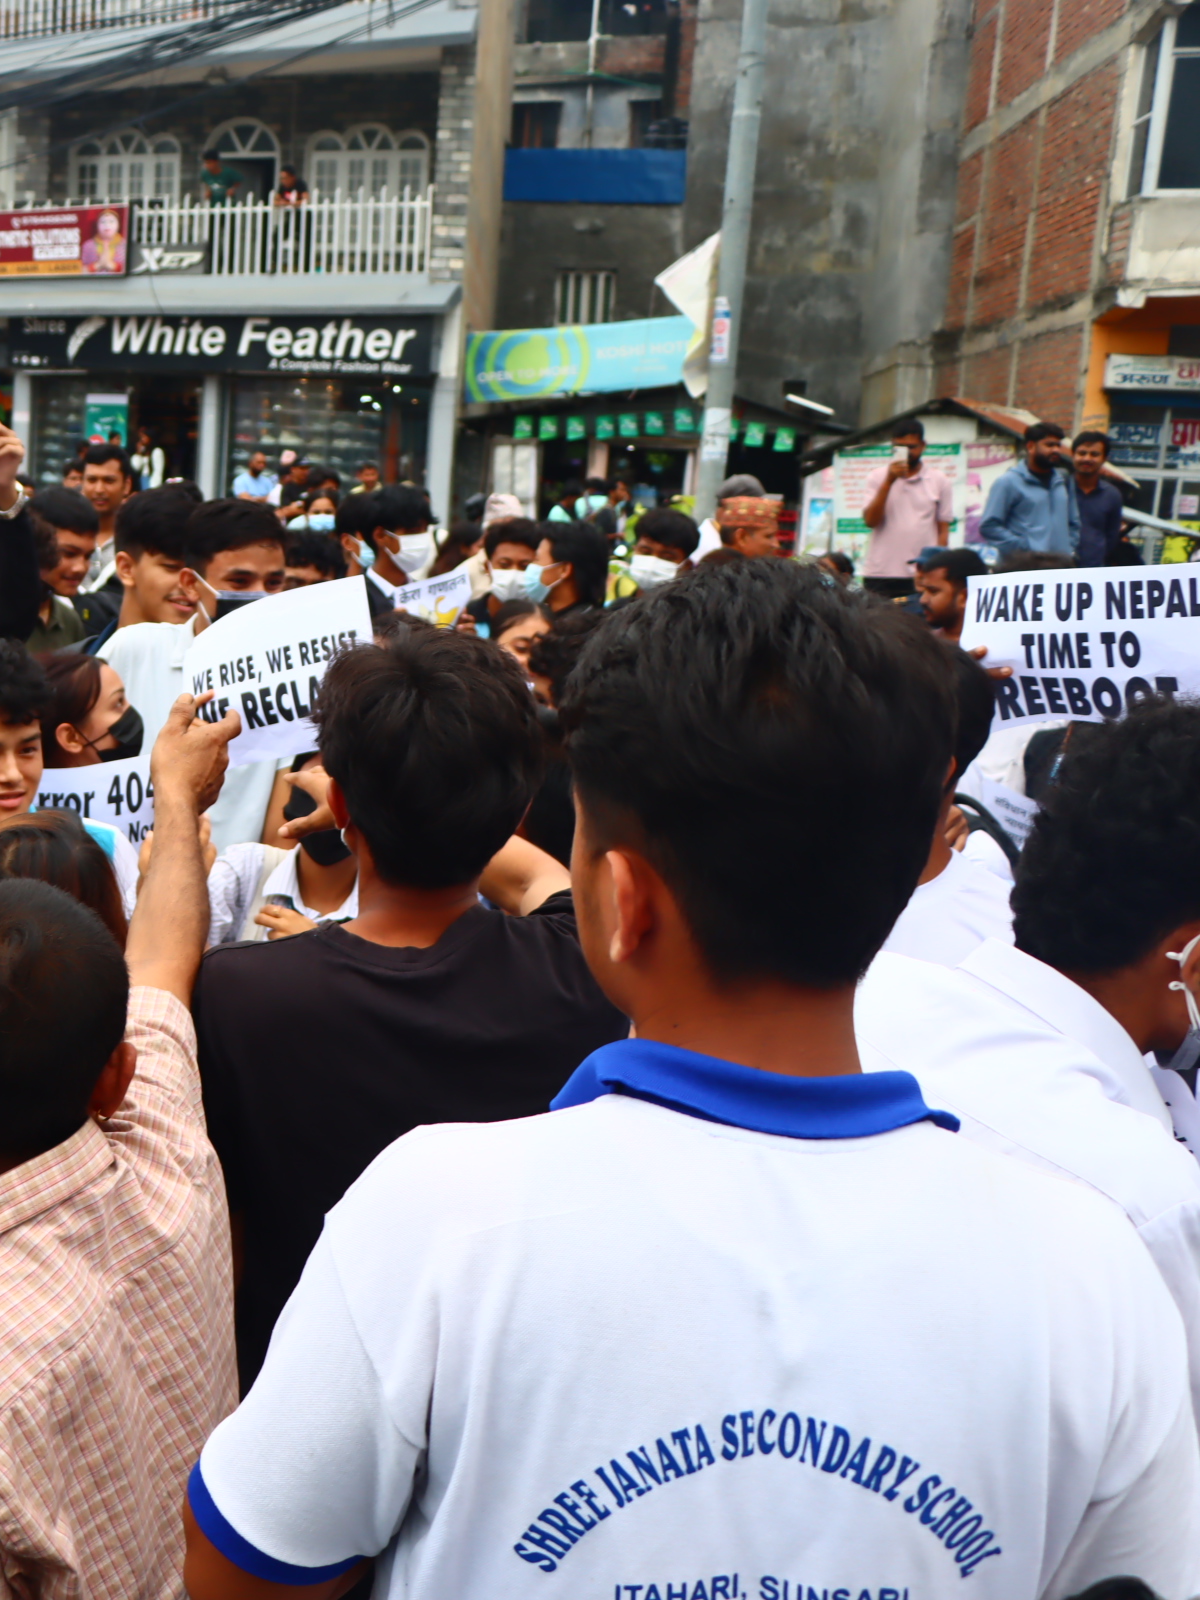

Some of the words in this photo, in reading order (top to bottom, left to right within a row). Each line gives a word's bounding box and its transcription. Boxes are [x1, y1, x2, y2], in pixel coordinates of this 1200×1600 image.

[23, 316, 66, 334] Shree
[111, 316, 226, 356] White
[237, 317, 417, 361] Feather
[267, 358, 278, 369] A
[280, 358, 332, 371] Complete
[333, 360, 380, 372] Fashion
[381, 361, 412, 374] Wear
[596, 344, 646, 359] KOSHI
[651, 340, 690, 355] HOT
[477, 369, 513, 383] OPEN
[517, 367, 536, 379] TO
[538, 364, 579, 378] MORE
[976, 584, 1043, 623] WAKE
[1055, 582, 1092, 622] UP
[1105, 578, 1200, 620] NEPAL
[193, 668, 214, 695] WE
[219, 655, 262, 687] RISE,
[265, 645, 293, 673] WE
[298, 630, 357, 666] RESIST
[1021, 632, 1092, 669] TIME
[1100, 630, 1141, 668] TO
[241, 675, 321, 730] RECLA
[38, 791, 95, 818] rror
[129, 821, 154, 843] No
[513, 1479, 611, 1573] SHREE
[594, 1423, 716, 1508] JANATA
[721, 1408, 920, 1502] SECONDARY
[903, 1474, 1002, 1579] SCHOOL
